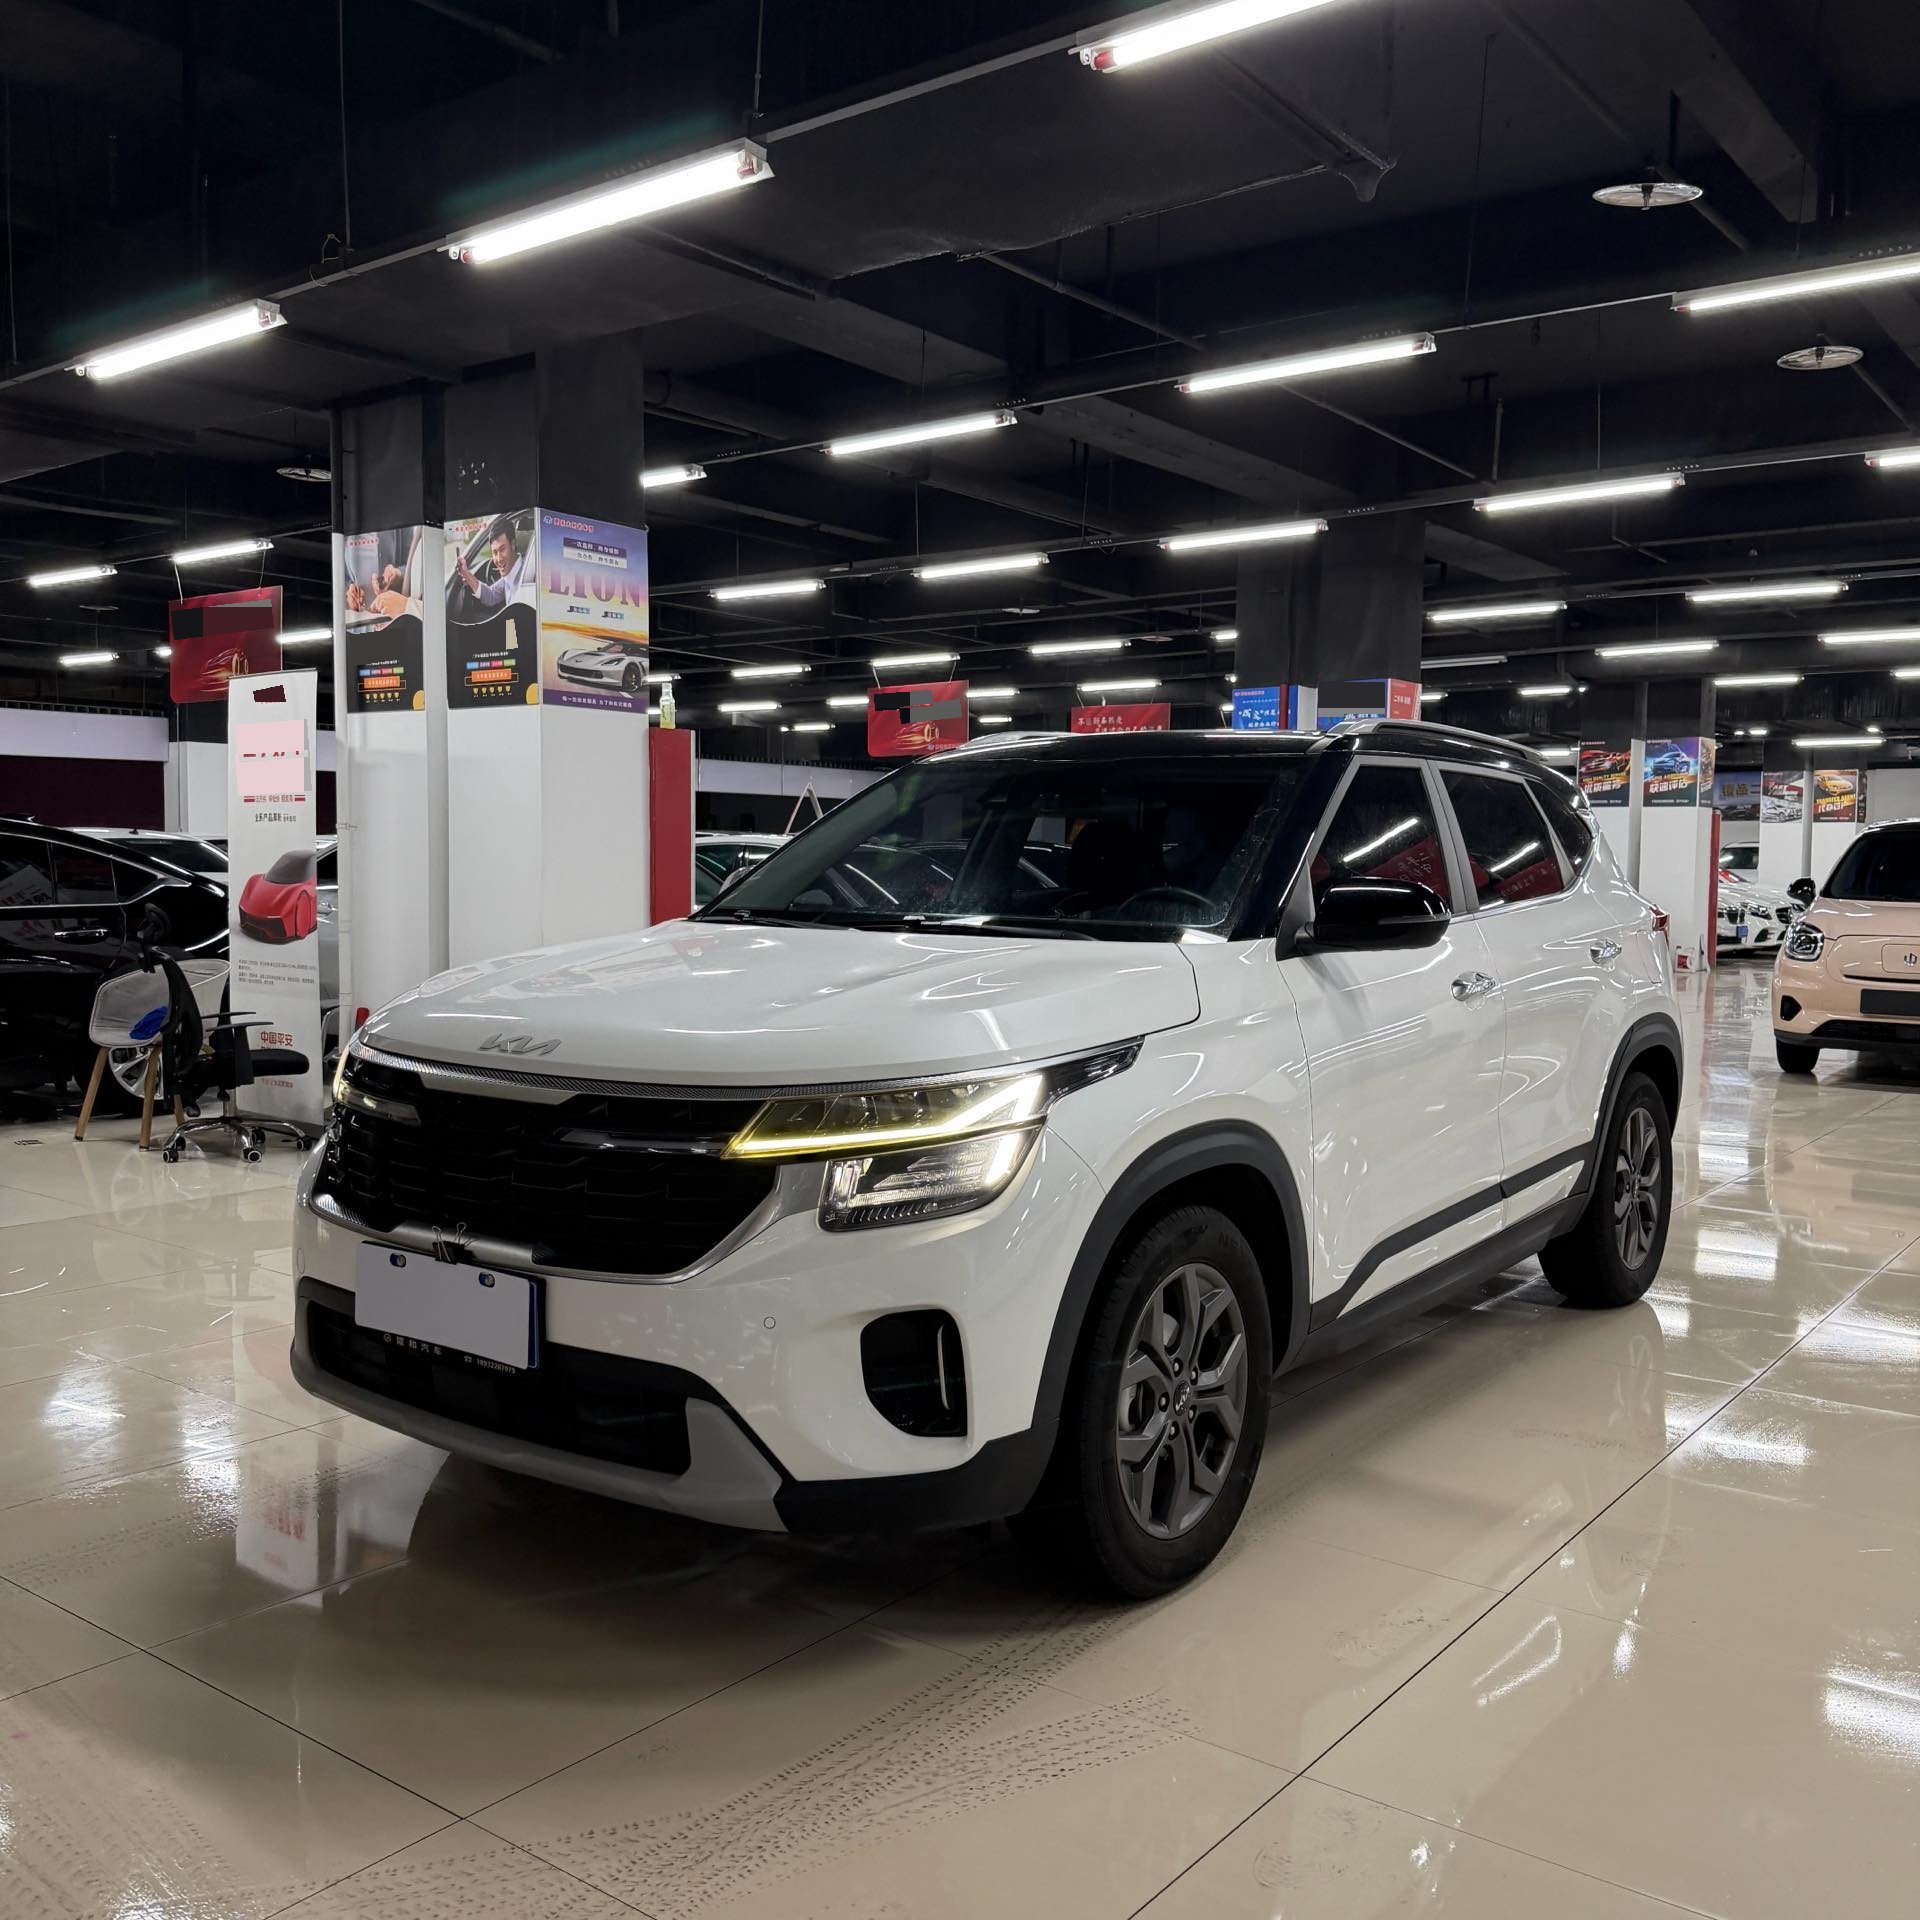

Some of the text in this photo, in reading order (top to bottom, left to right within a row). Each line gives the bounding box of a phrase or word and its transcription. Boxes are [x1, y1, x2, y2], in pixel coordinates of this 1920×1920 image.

[549, 567, 640, 608] LION
[260, 1031, 294, 1047] 中国平安
[478, 1033, 562, 1056] KIA
